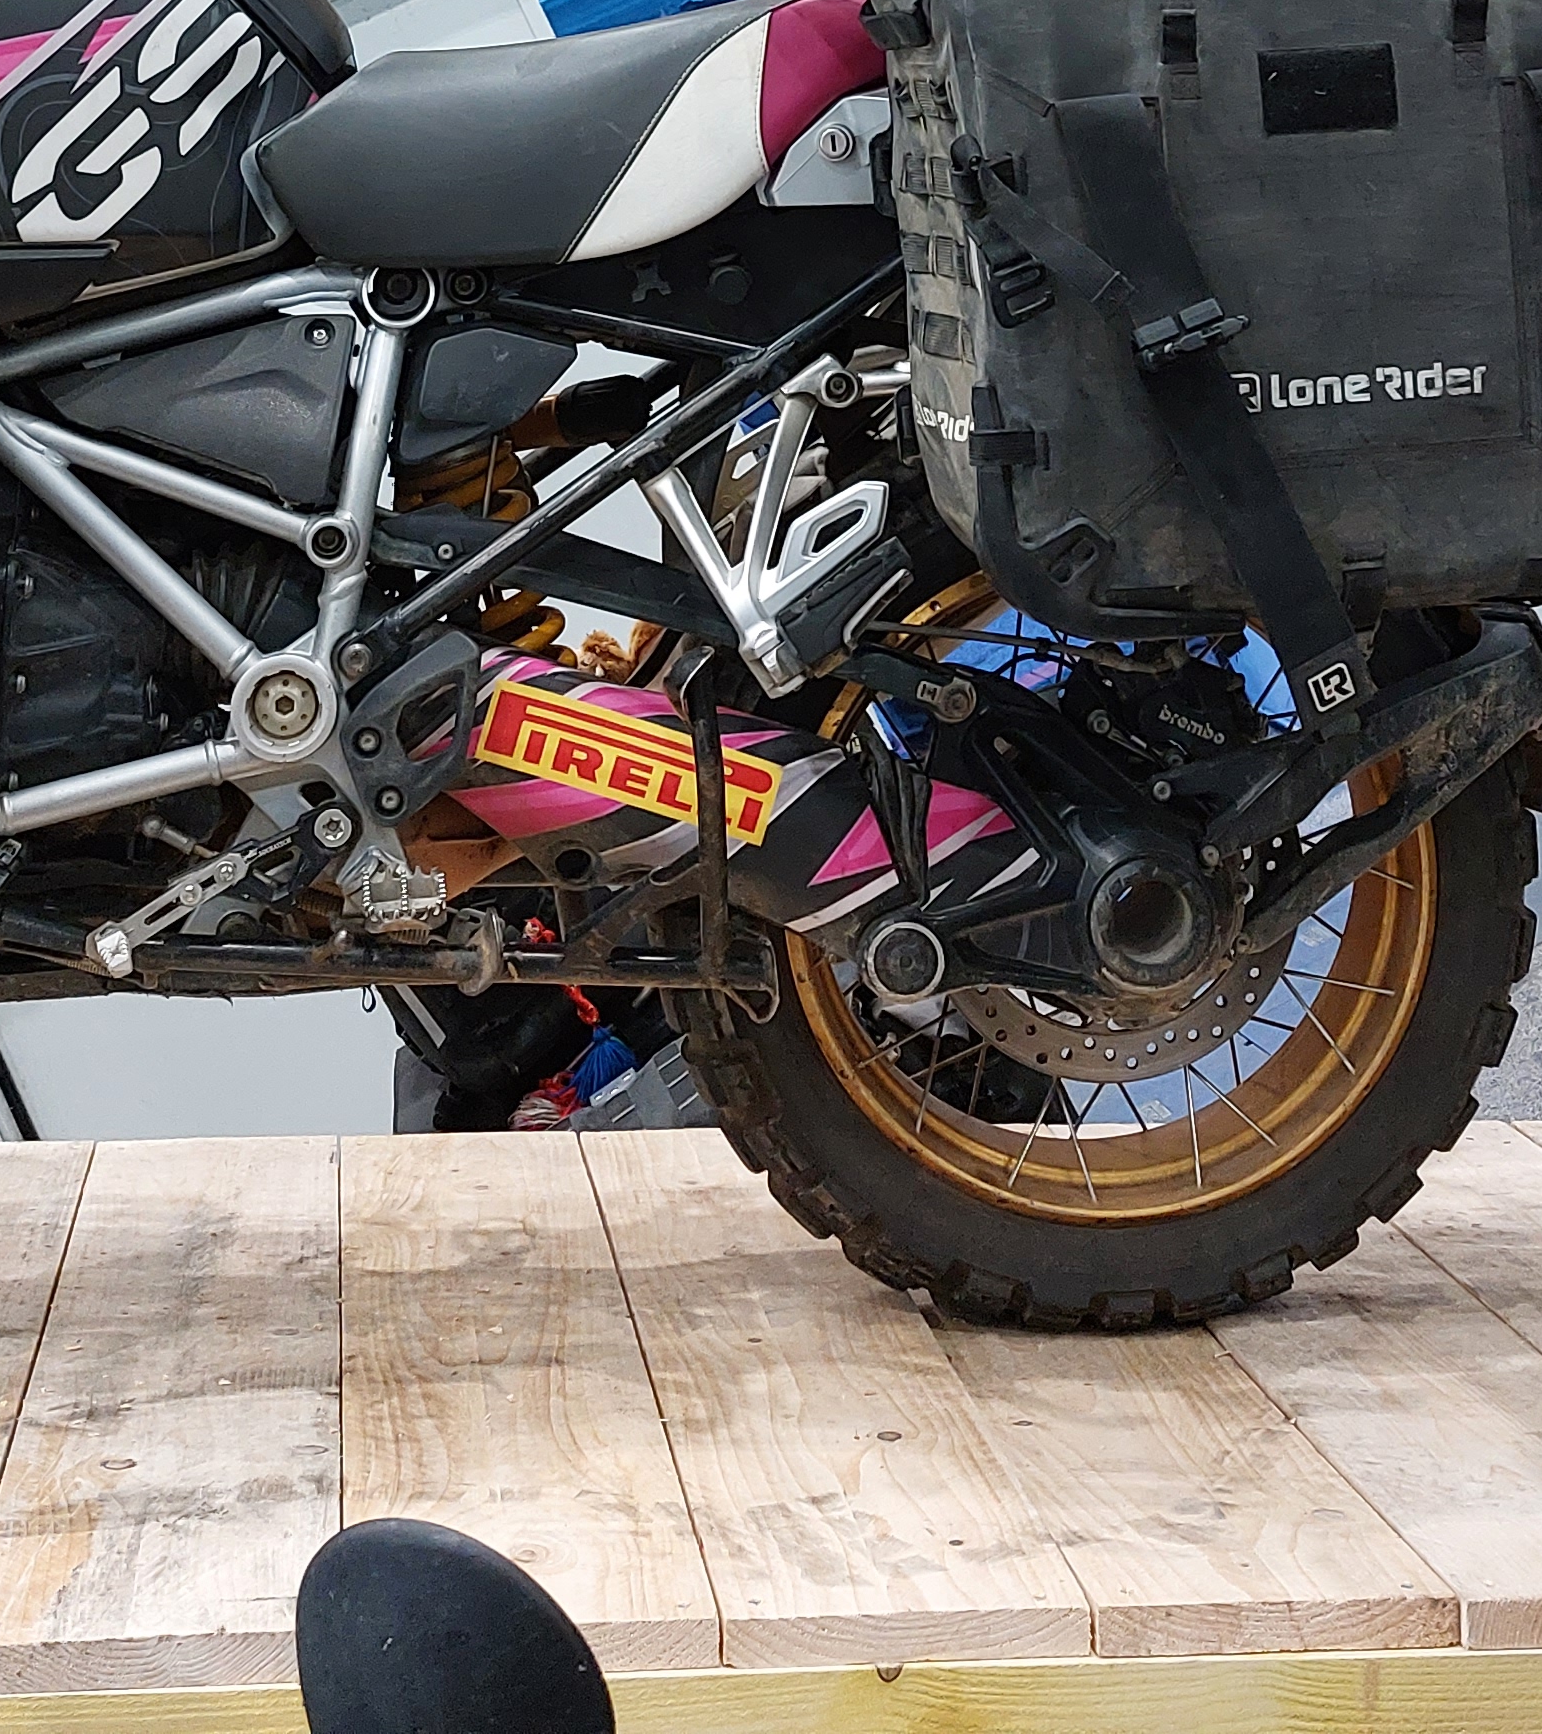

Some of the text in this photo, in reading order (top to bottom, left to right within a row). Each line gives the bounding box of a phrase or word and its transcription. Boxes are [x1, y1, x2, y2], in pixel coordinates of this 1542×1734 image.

[1270, 373, 1372, 408] Lone
[1375, 361, 1487, 401] Rider
[1158, 703, 1226, 745] brembo
[483, 689, 773, 834] PIRELI
